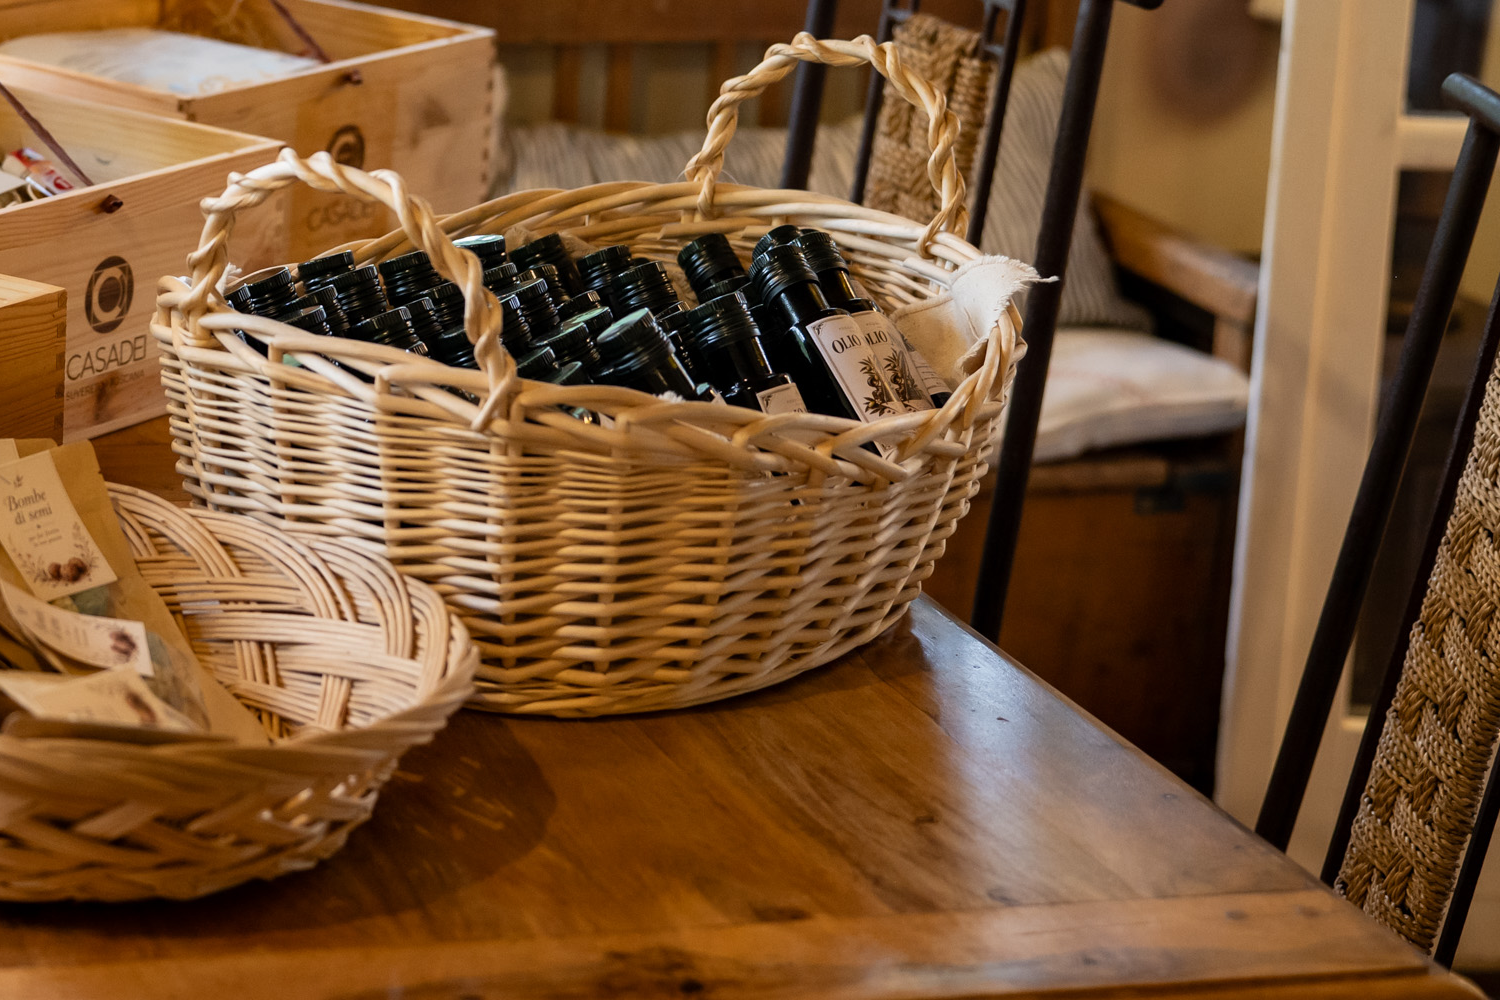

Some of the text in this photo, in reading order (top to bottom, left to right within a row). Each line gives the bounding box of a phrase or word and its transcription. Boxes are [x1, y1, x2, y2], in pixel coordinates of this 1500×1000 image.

[832, 334, 861, 354] OLIO
[66, 334, 147, 381] CASADEI
[4, 488, 46, 511] Bombe
[15, 503, 52, 525] di semi
